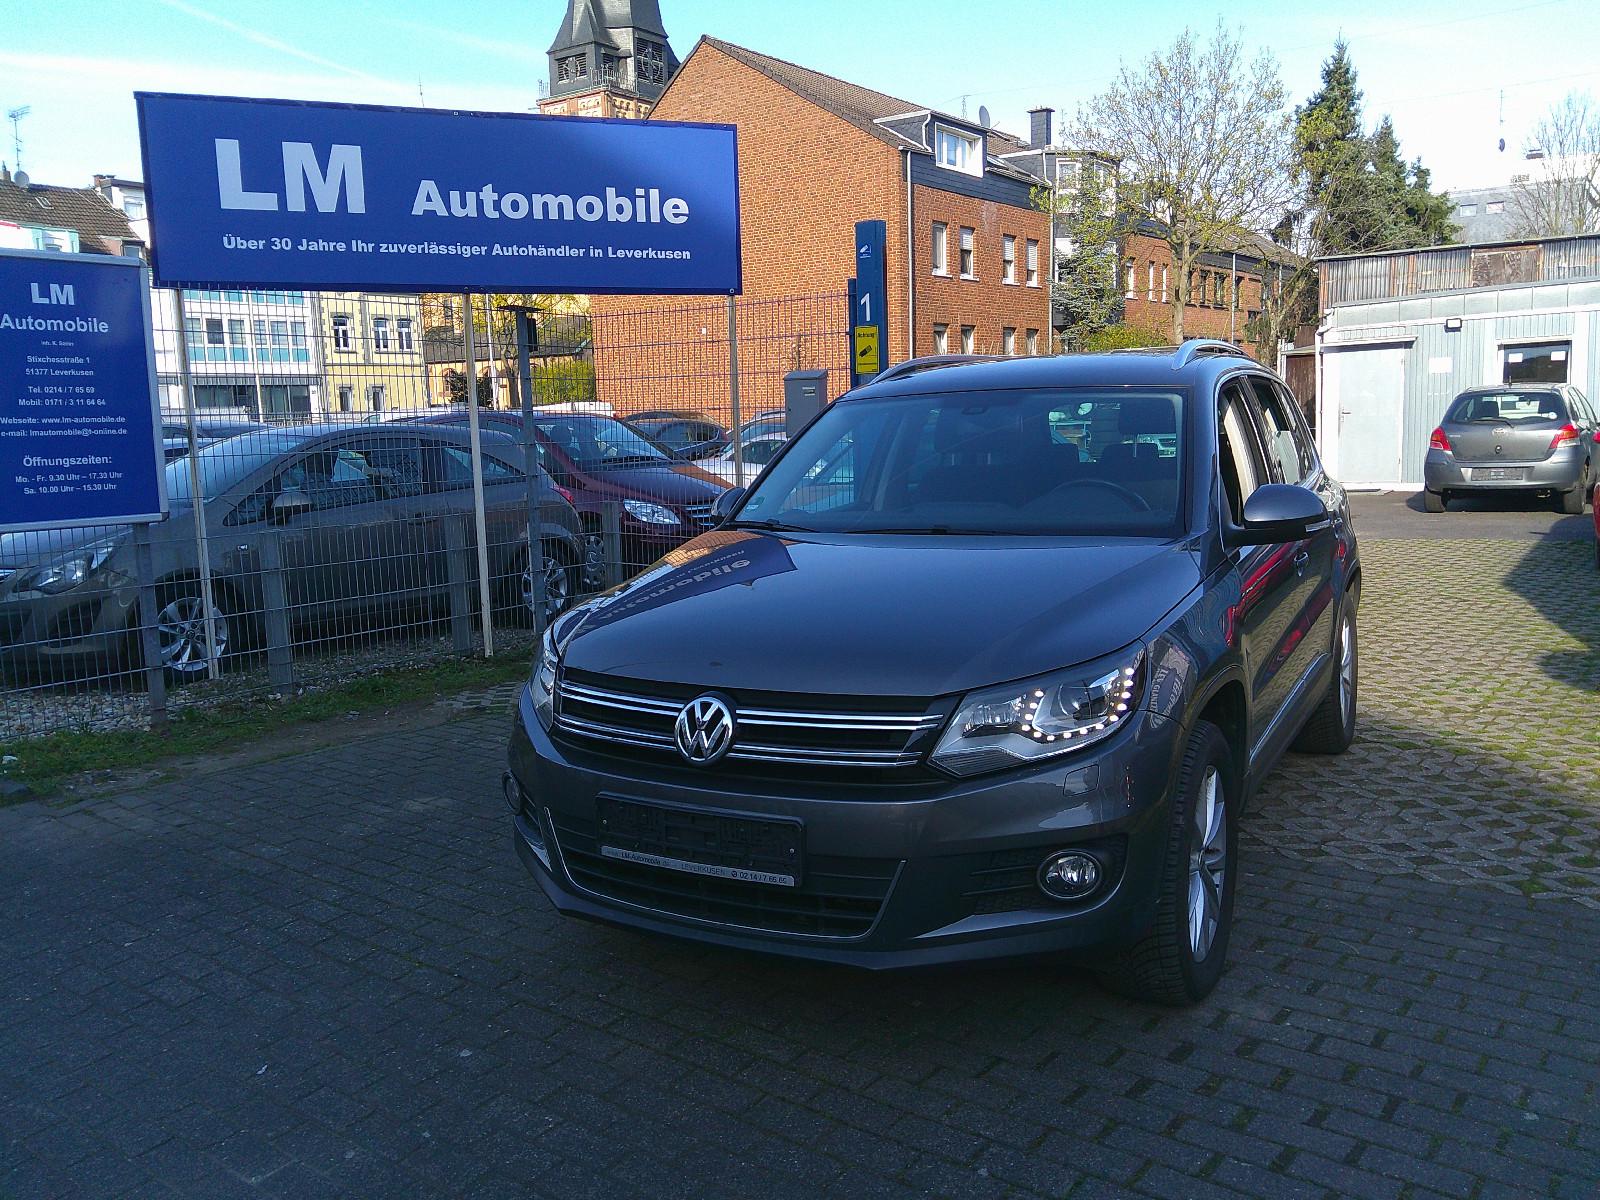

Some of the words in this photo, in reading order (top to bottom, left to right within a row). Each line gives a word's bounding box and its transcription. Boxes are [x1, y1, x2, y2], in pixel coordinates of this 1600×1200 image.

[214, 138, 366, 214] LM
[411, 180, 690, 225] Automobile
[222, 235, 266, 251] Über
[270, 237, 292, 251] 30
[297, 238, 347, 253] Jahre
[351, 239, 374, 254] Ihr
[379, 239, 487, 258] zuverlässiger
[491, 243, 585, 258] Autohändler
[589, 245, 604, 258] in
[607, 246, 691, 260] Leverkusen
[30, 282, 75, 305] LM
[860, 293, 870, 321] 1
[0, 313, 109, 333] Automobile
[41, 416, 126, 424] www.lm-automobile.de
[1, 429, 27, 437] e-mail:
[29, 428, 127, 437] lmautomobile@t-online.de
[23, 455, 113, 468] Öffnungszeiten:
[15, 475, 30, 483] Mo.
[48, 474, 65, 482] 9.30
[88, 472, 108, 480] 17.30
[109, 471, 123, 479] Uhr
[23, 487, 37, 495] Sa.
[38, 486, 59, 494] 10.00
[60, 485, 74, 493] Uhr
[83, 484, 102, 492] 15.30
